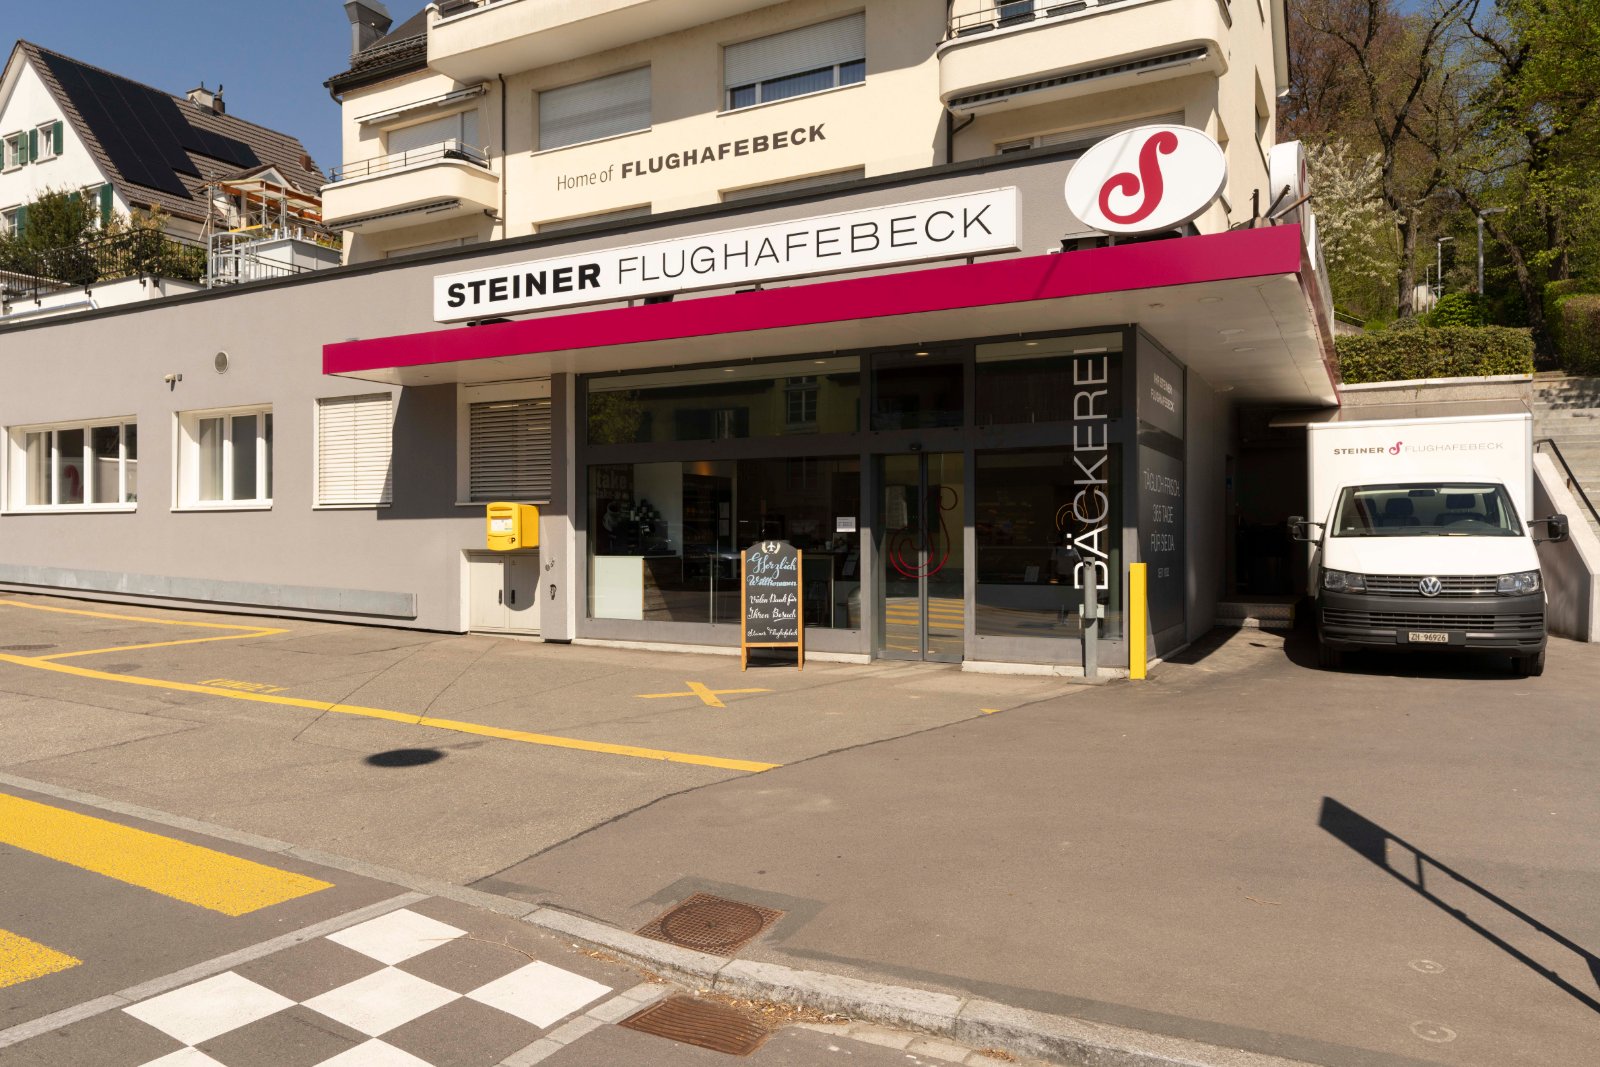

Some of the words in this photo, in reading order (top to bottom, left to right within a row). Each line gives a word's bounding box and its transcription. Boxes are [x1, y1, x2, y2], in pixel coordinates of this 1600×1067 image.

[557, 172, 597, 191] Home
[599, 164, 615, 183] of
[621, 123, 827, 179] FLUGHAFEBECK
[447, 262, 601, 308] STEINER
[618, 204, 993, 285] FLUGHAFEBECK
[1333, 446, 1385, 455] STEINER
[1404, 442, 1504, 453] FLUGHAFEBECK
[747, 574, 797, 587] Willkommen
[750, 593, 768, 604] Vielen
[769, 593, 787, 603] Dank
[786, 592, 797, 606] für
[747, 606, 769, 620] Ihren
[772, 607, 797, 620] Besuch
